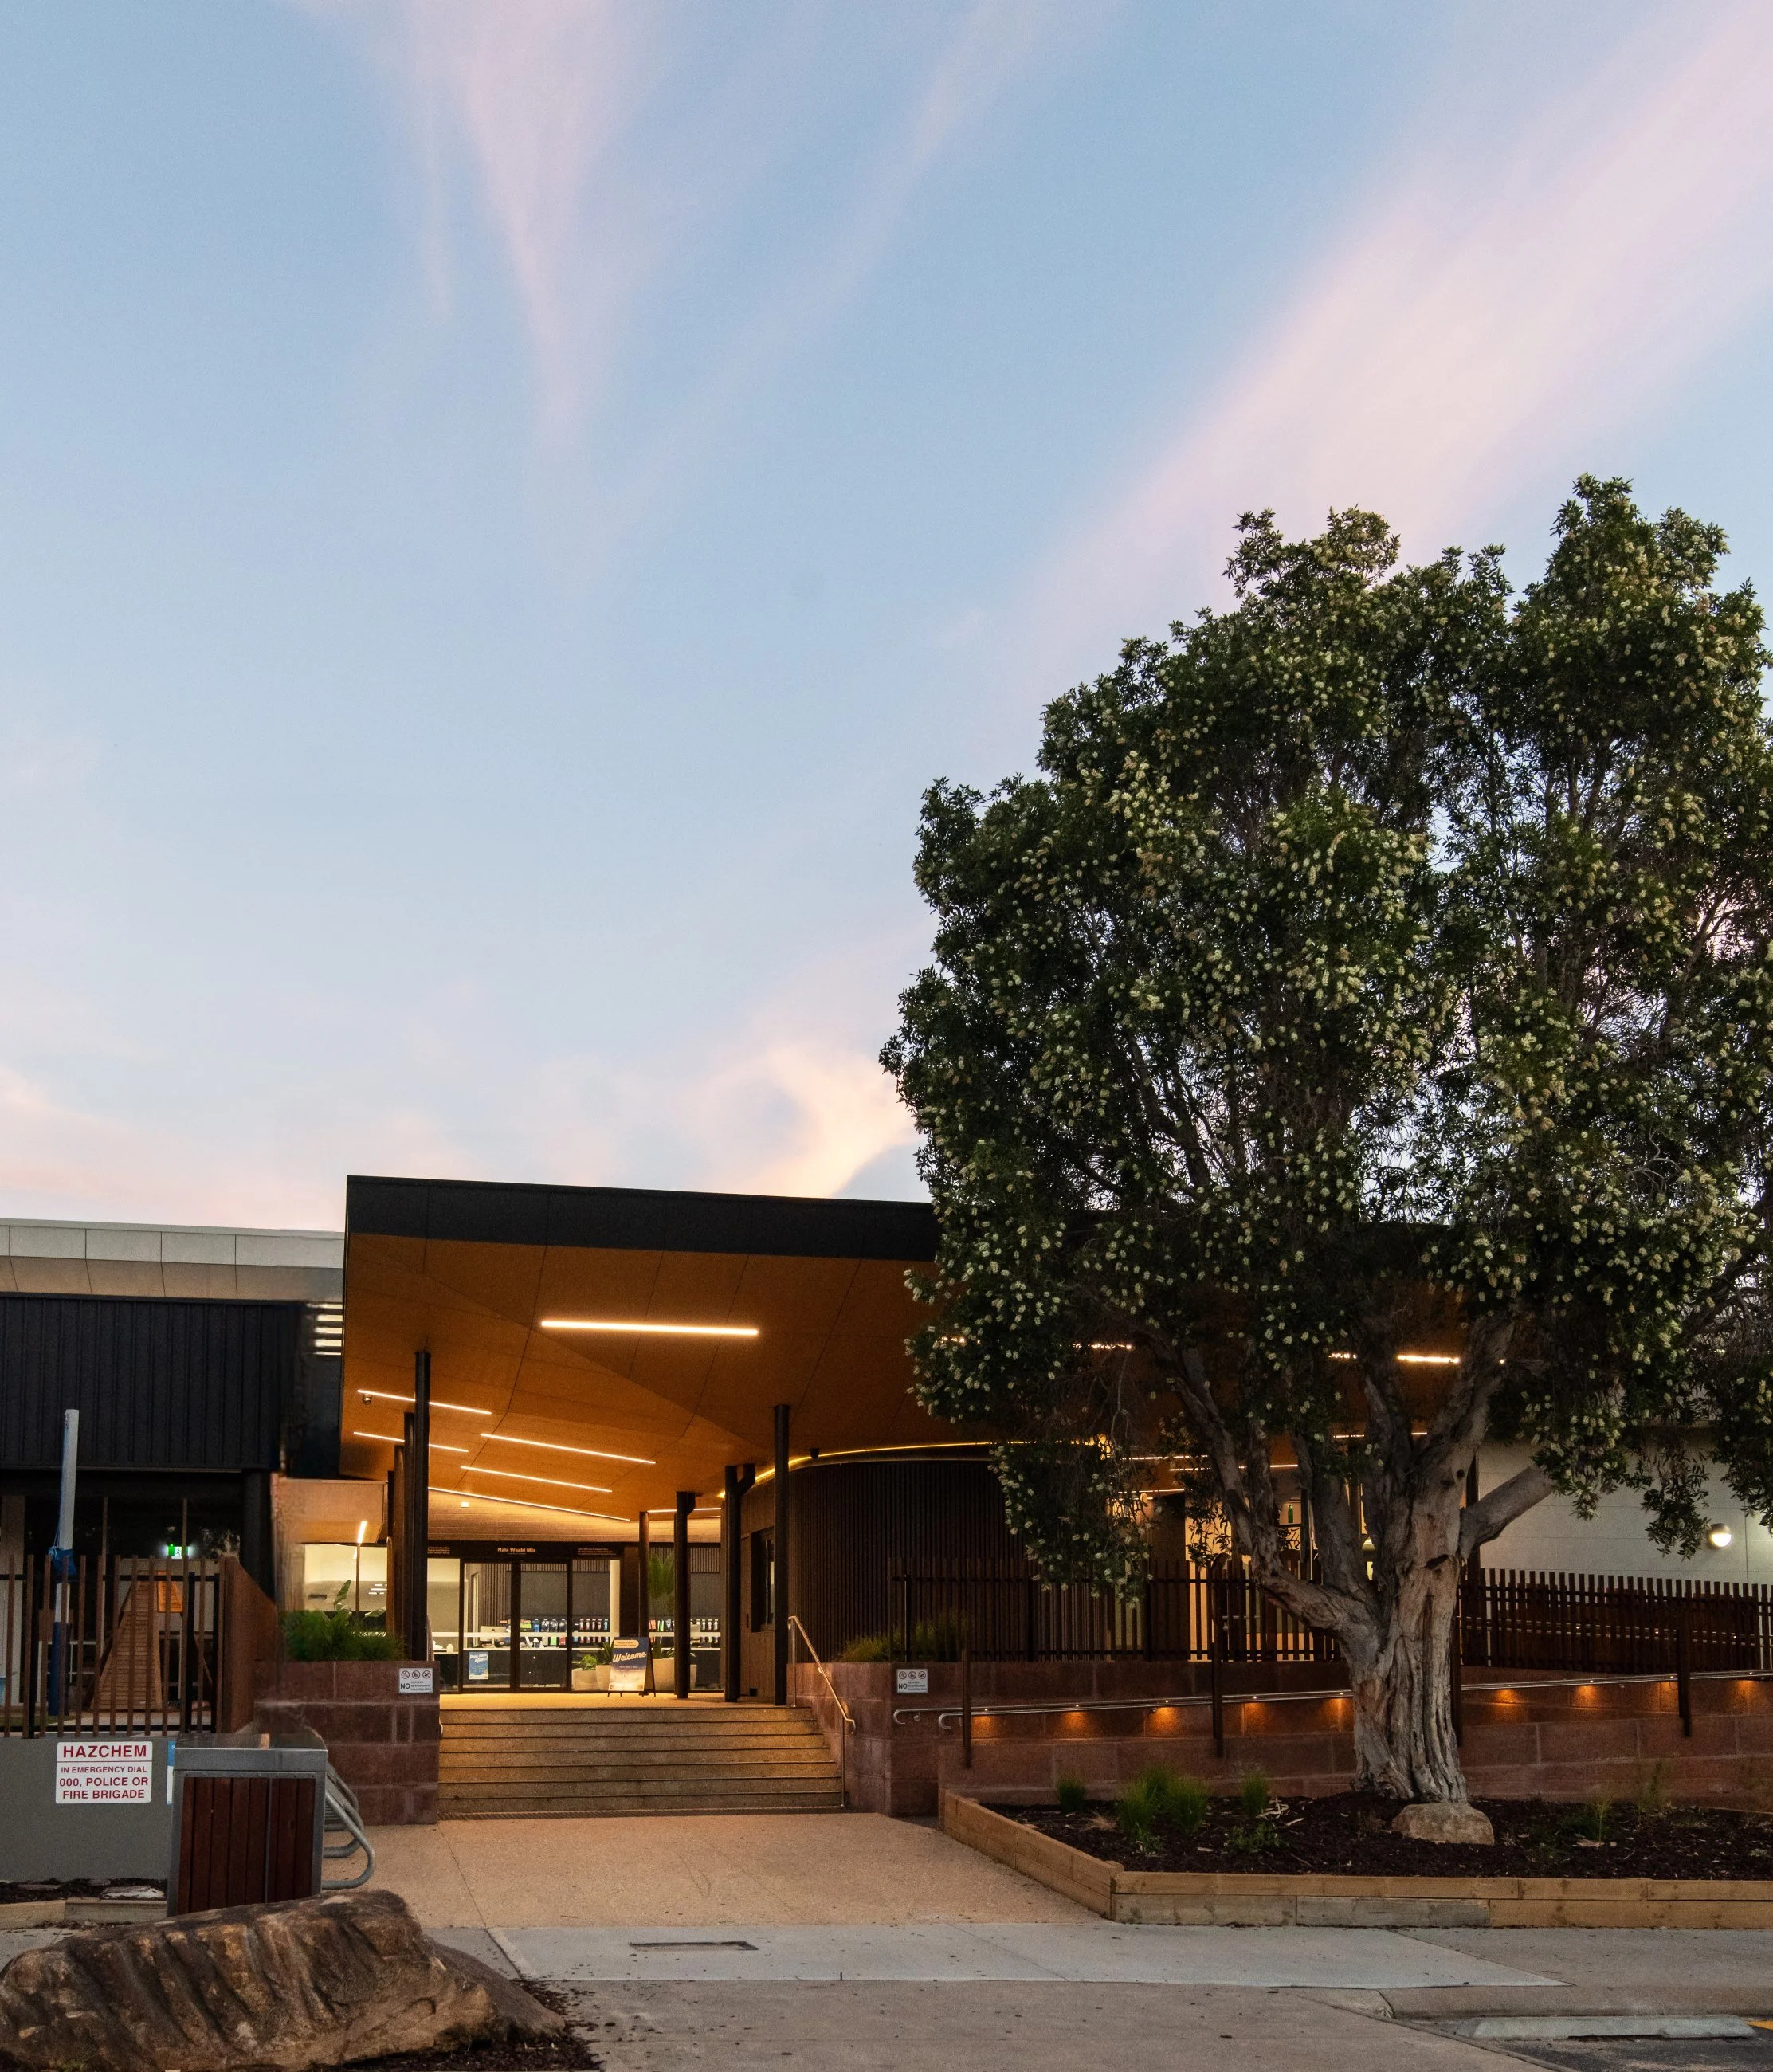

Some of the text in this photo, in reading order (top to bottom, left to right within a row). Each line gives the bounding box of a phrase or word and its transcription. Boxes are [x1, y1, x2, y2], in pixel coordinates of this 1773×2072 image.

[612, 1651, 647, 1662] Welcome
[63, 1744, 147, 1758] HAZCHEM
[59, 1776, 148, 1787] 000, POLICE OR
[62, 1789, 145, 1799] FIRE BRIGADE
